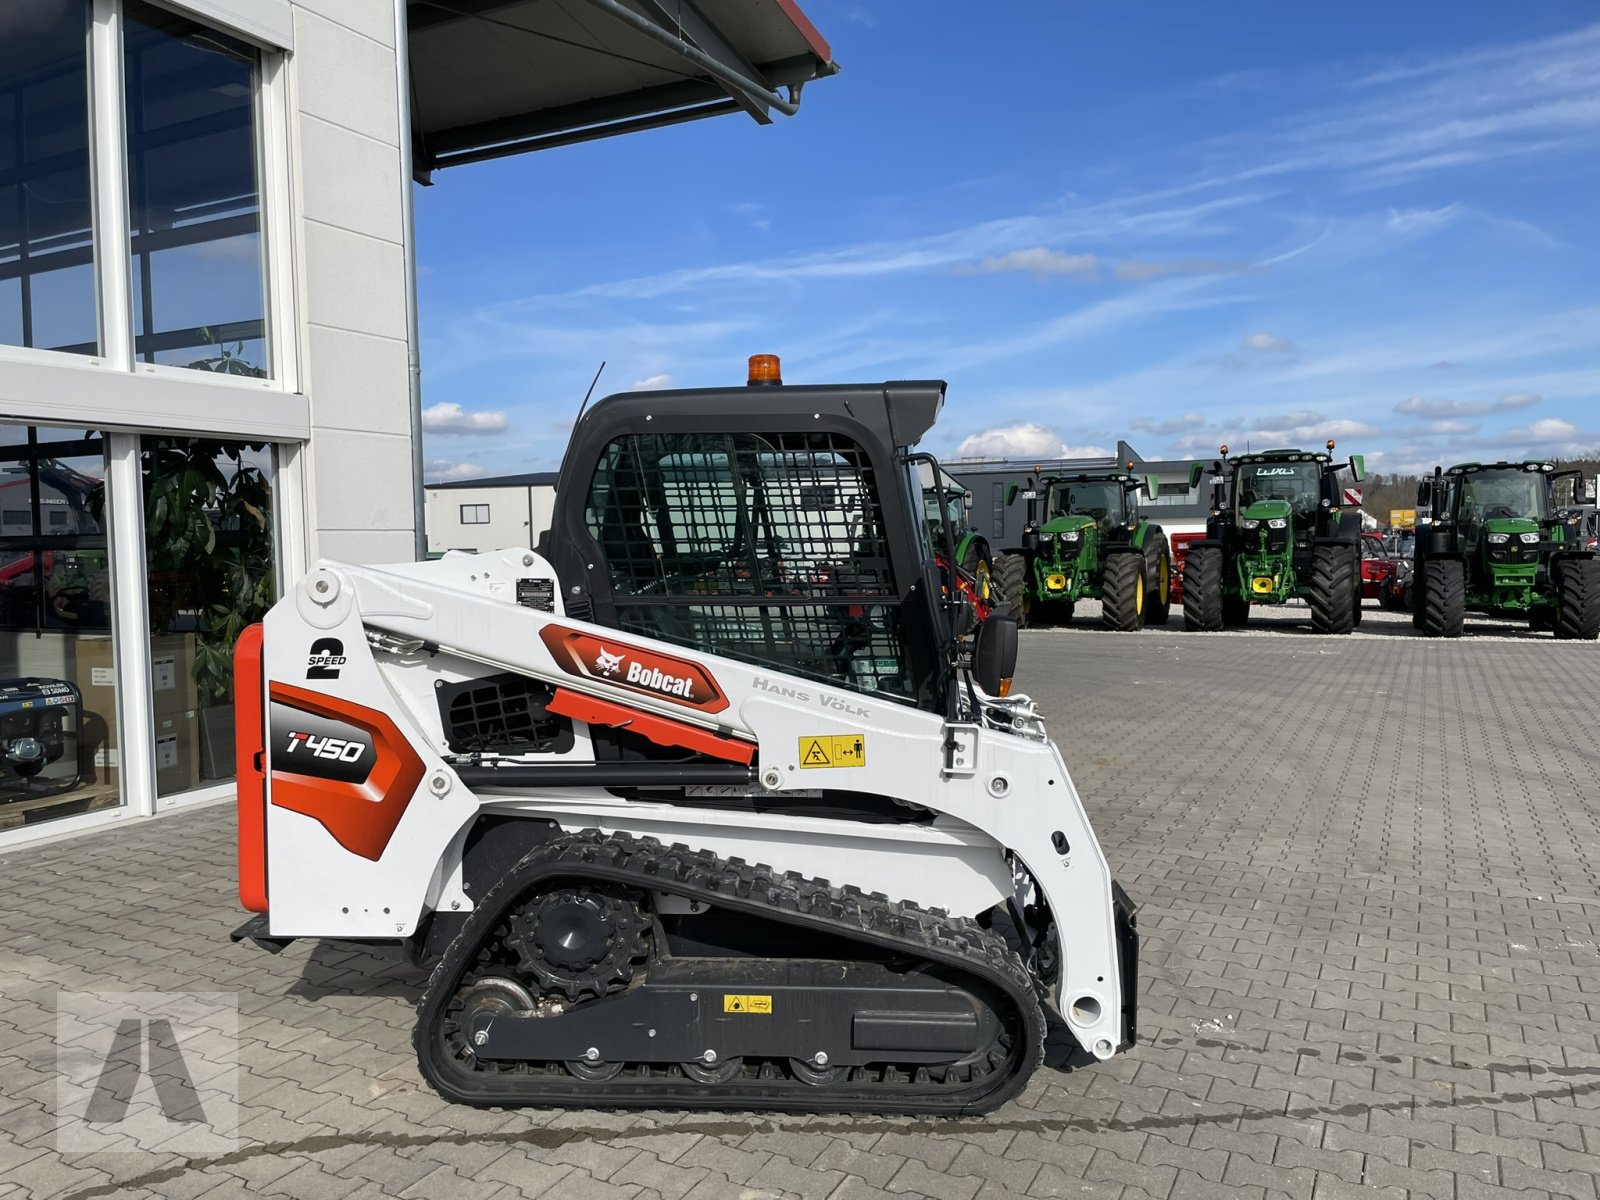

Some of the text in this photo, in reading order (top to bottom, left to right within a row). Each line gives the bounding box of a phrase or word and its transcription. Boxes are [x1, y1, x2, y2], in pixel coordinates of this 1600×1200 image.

[305, 637, 344, 680] 2
[308, 656, 347, 665] SPEED
[626, 661, 693, 698] Bobcat
[752, 677, 810, 702] HANS
[286, 731, 366, 763] T450
